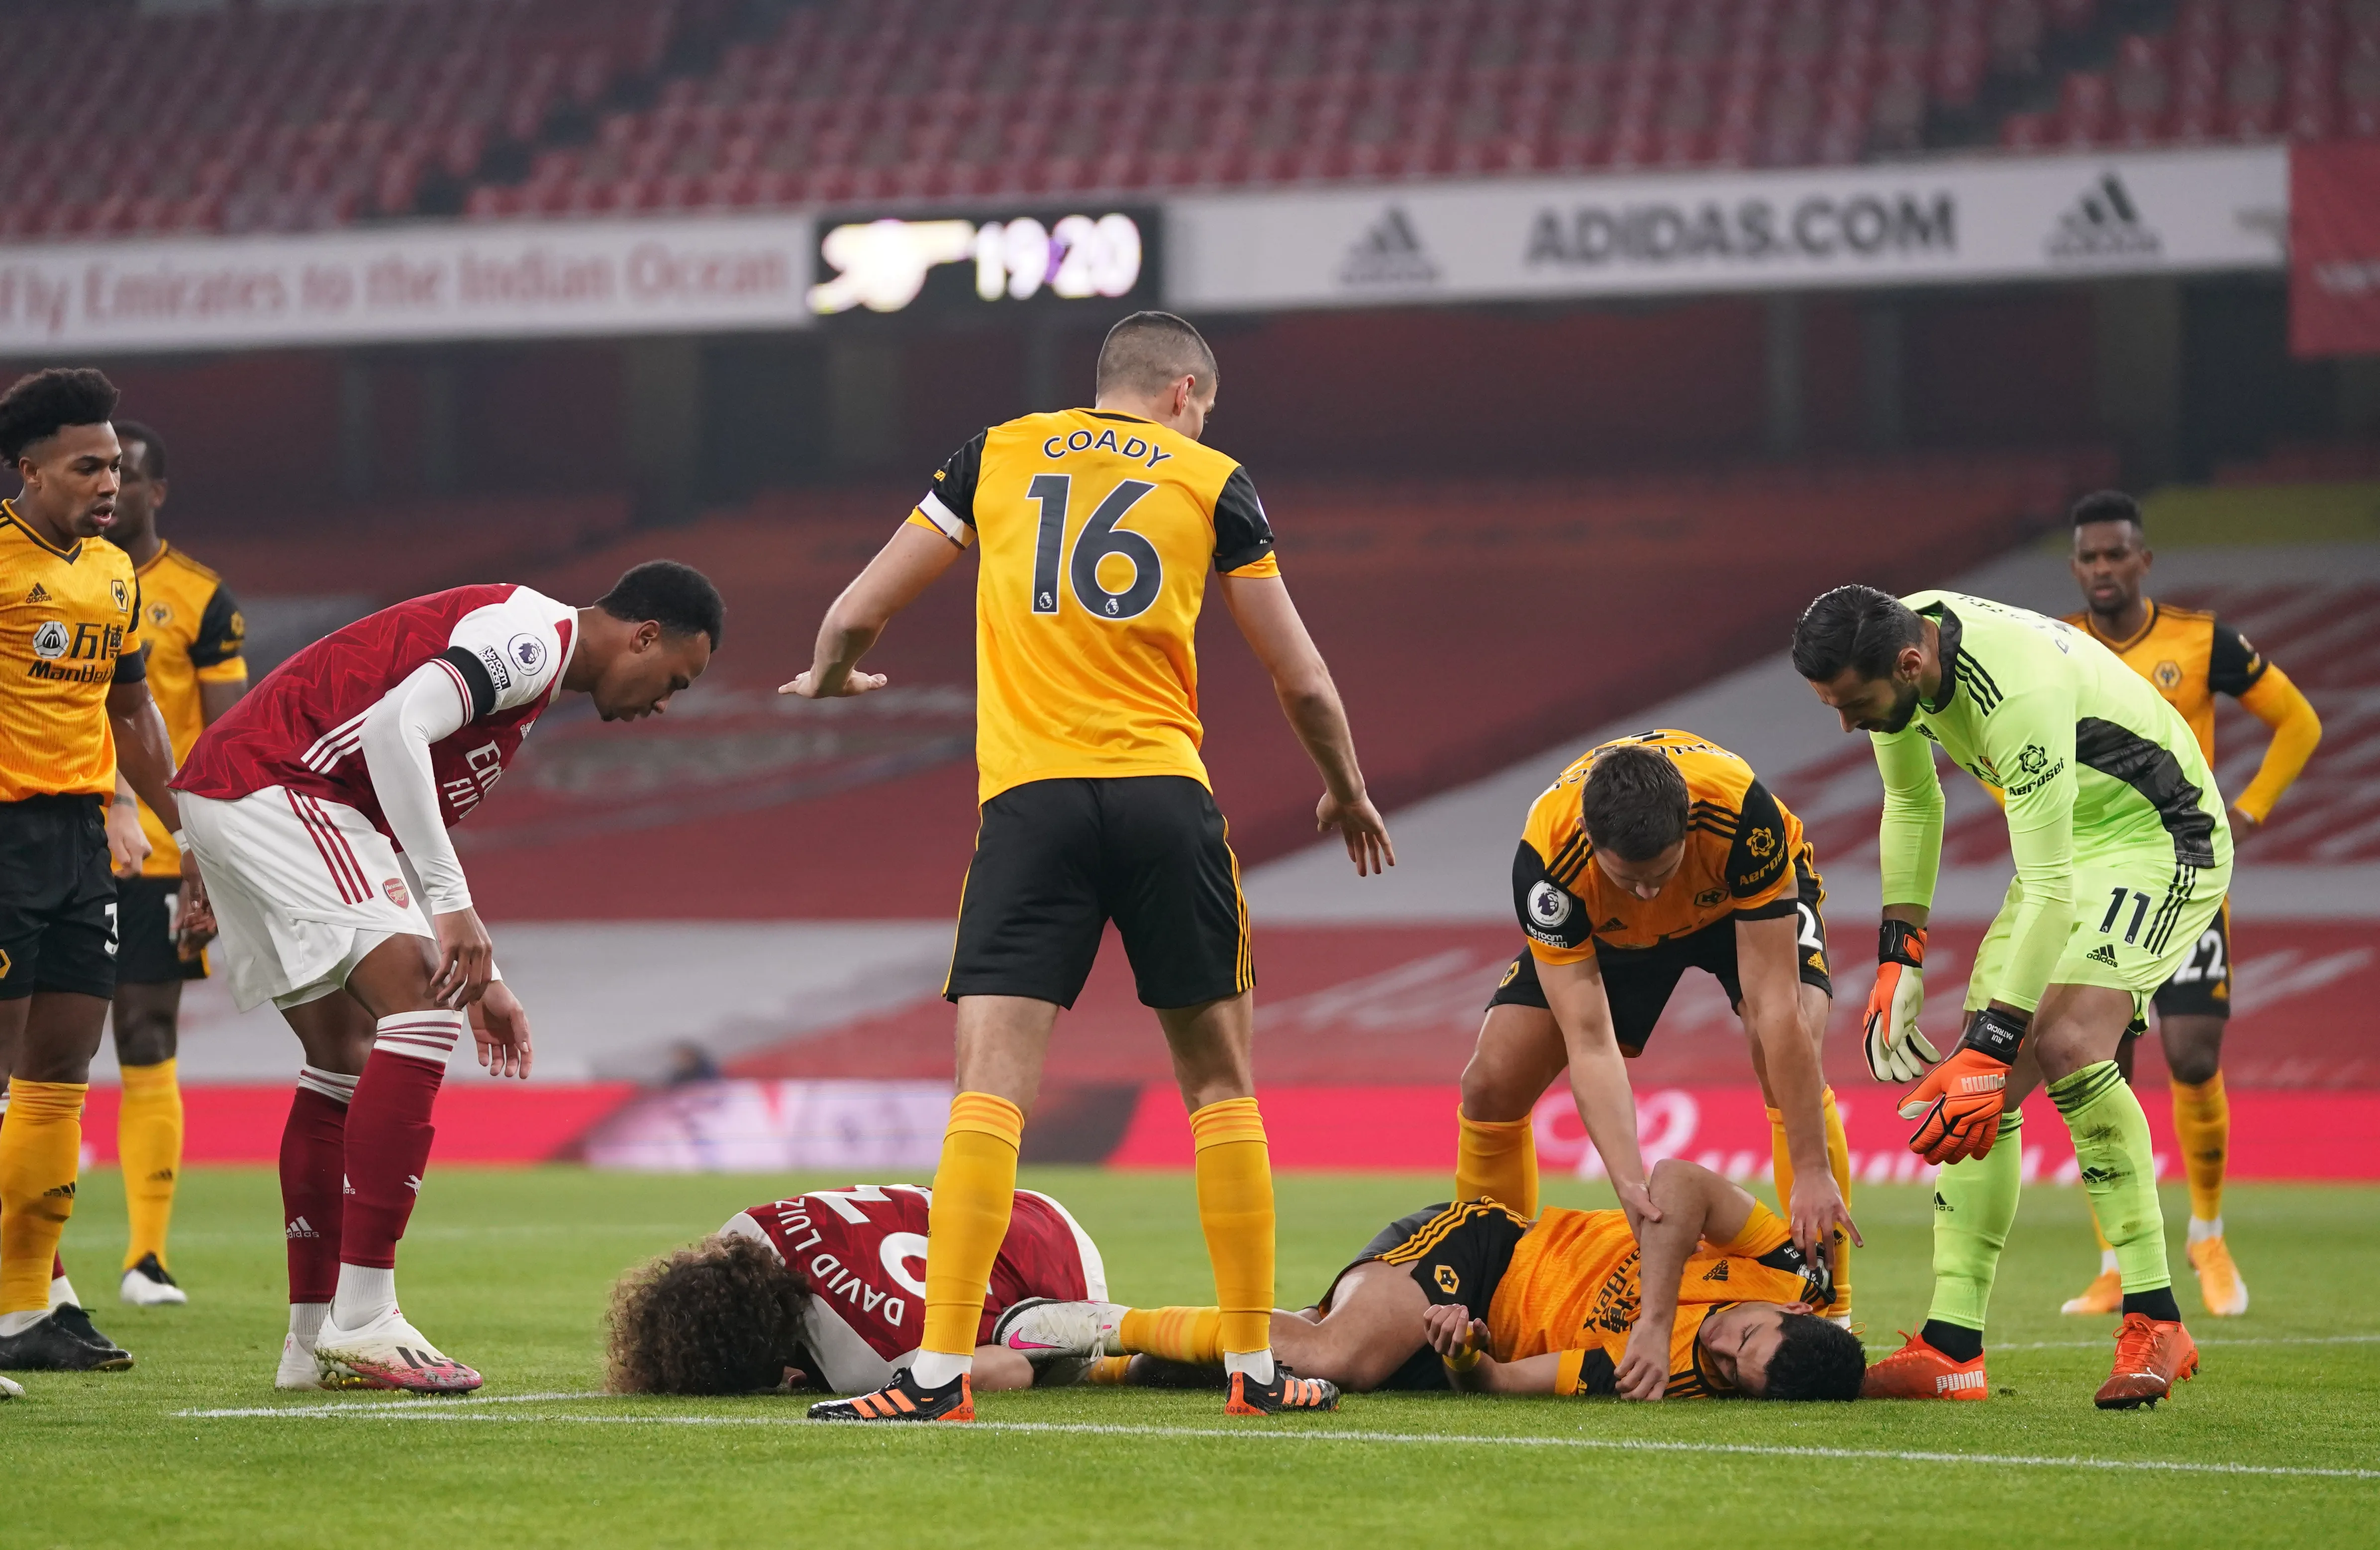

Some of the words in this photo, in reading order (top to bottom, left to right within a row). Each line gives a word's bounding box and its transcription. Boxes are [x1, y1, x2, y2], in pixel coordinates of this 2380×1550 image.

[1526, 192, 1957, 269] ADIDAS.COM
[84, 264, 289, 320] Emirates
[300, 260, 354, 312] to
[367, 252, 441, 309] the
[459, 248, 615, 305] Indian
[626, 241, 790, 300] Ocean
[1044, 429, 1173, 469] COADY
[1025, 474, 1163, 620] 16
[25, 595, 52, 604] adidas
[488, 660, 503, 692] racism
[494, 659, 508, 685] room
[2009, 756, 2065, 797] Aeroset
[2099, 887, 2152, 945] 11
[1538, 931, 1563, 941] room
[2086, 952, 2118, 968] adidas
[2173, 929, 2227, 985] 22
[1986, 1023, 2014, 1040] PATRICIO
[1991, 1034, 2003, 1044] RUI
[1961, 1073, 2006, 1093] PUMA
[775, 1197, 822, 1251] LUIZ
[1702, 1259, 1728, 1281] adidas
[811, 1253, 905, 1327] DAVID
[1583, 1246, 1641, 1334] anBetX
[1936, 1370, 1984, 1394] PUMA
